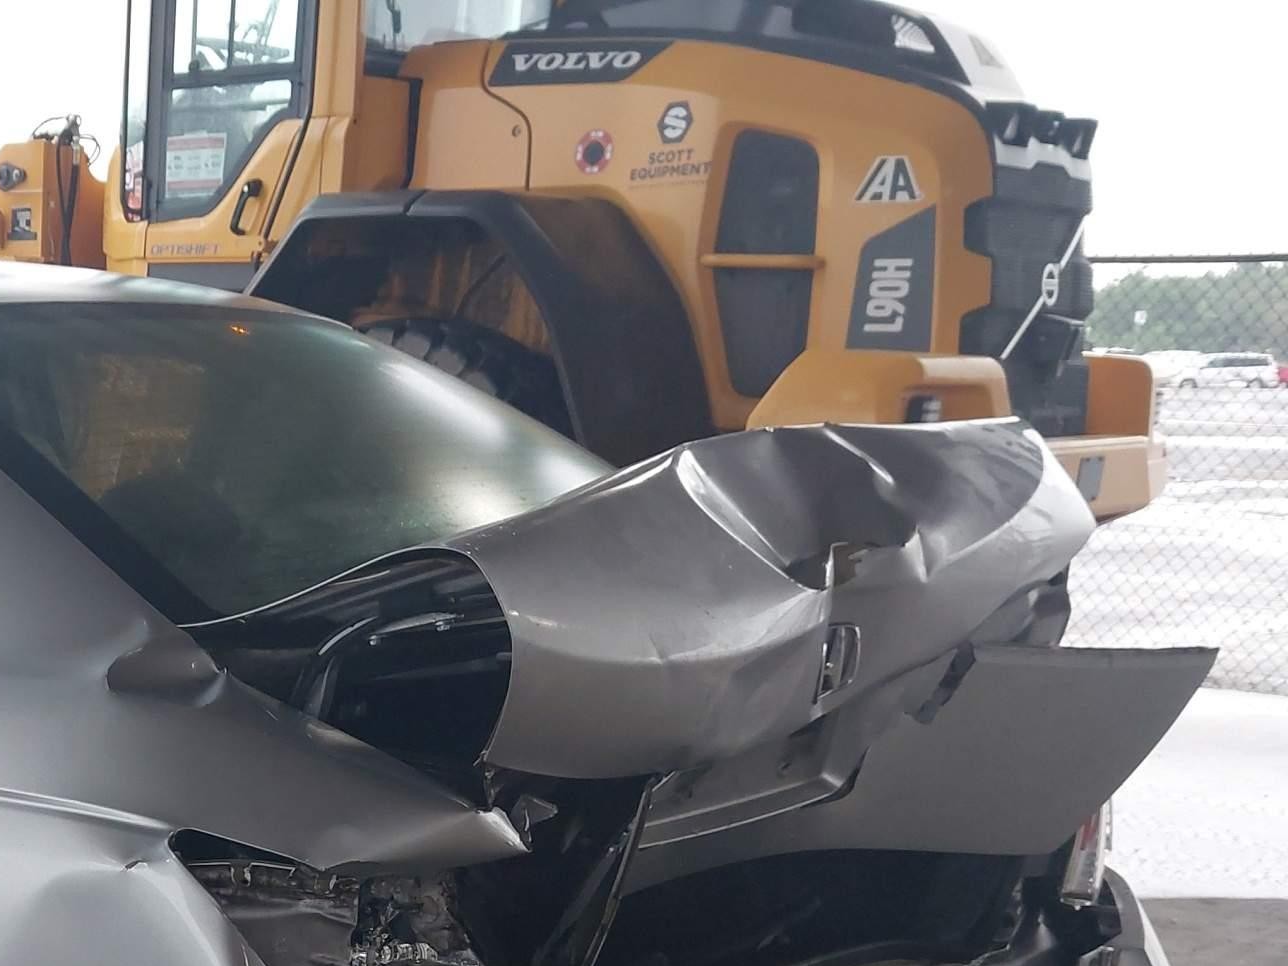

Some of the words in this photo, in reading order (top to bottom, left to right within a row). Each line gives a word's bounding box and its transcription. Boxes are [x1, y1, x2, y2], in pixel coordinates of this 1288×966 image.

[511, 50, 642, 72] VOLVO
[647, 147, 695, 166] SCOTT
[629, 160, 713, 182] EQUIPMENT
[863, 257, 914, 333] L90H
